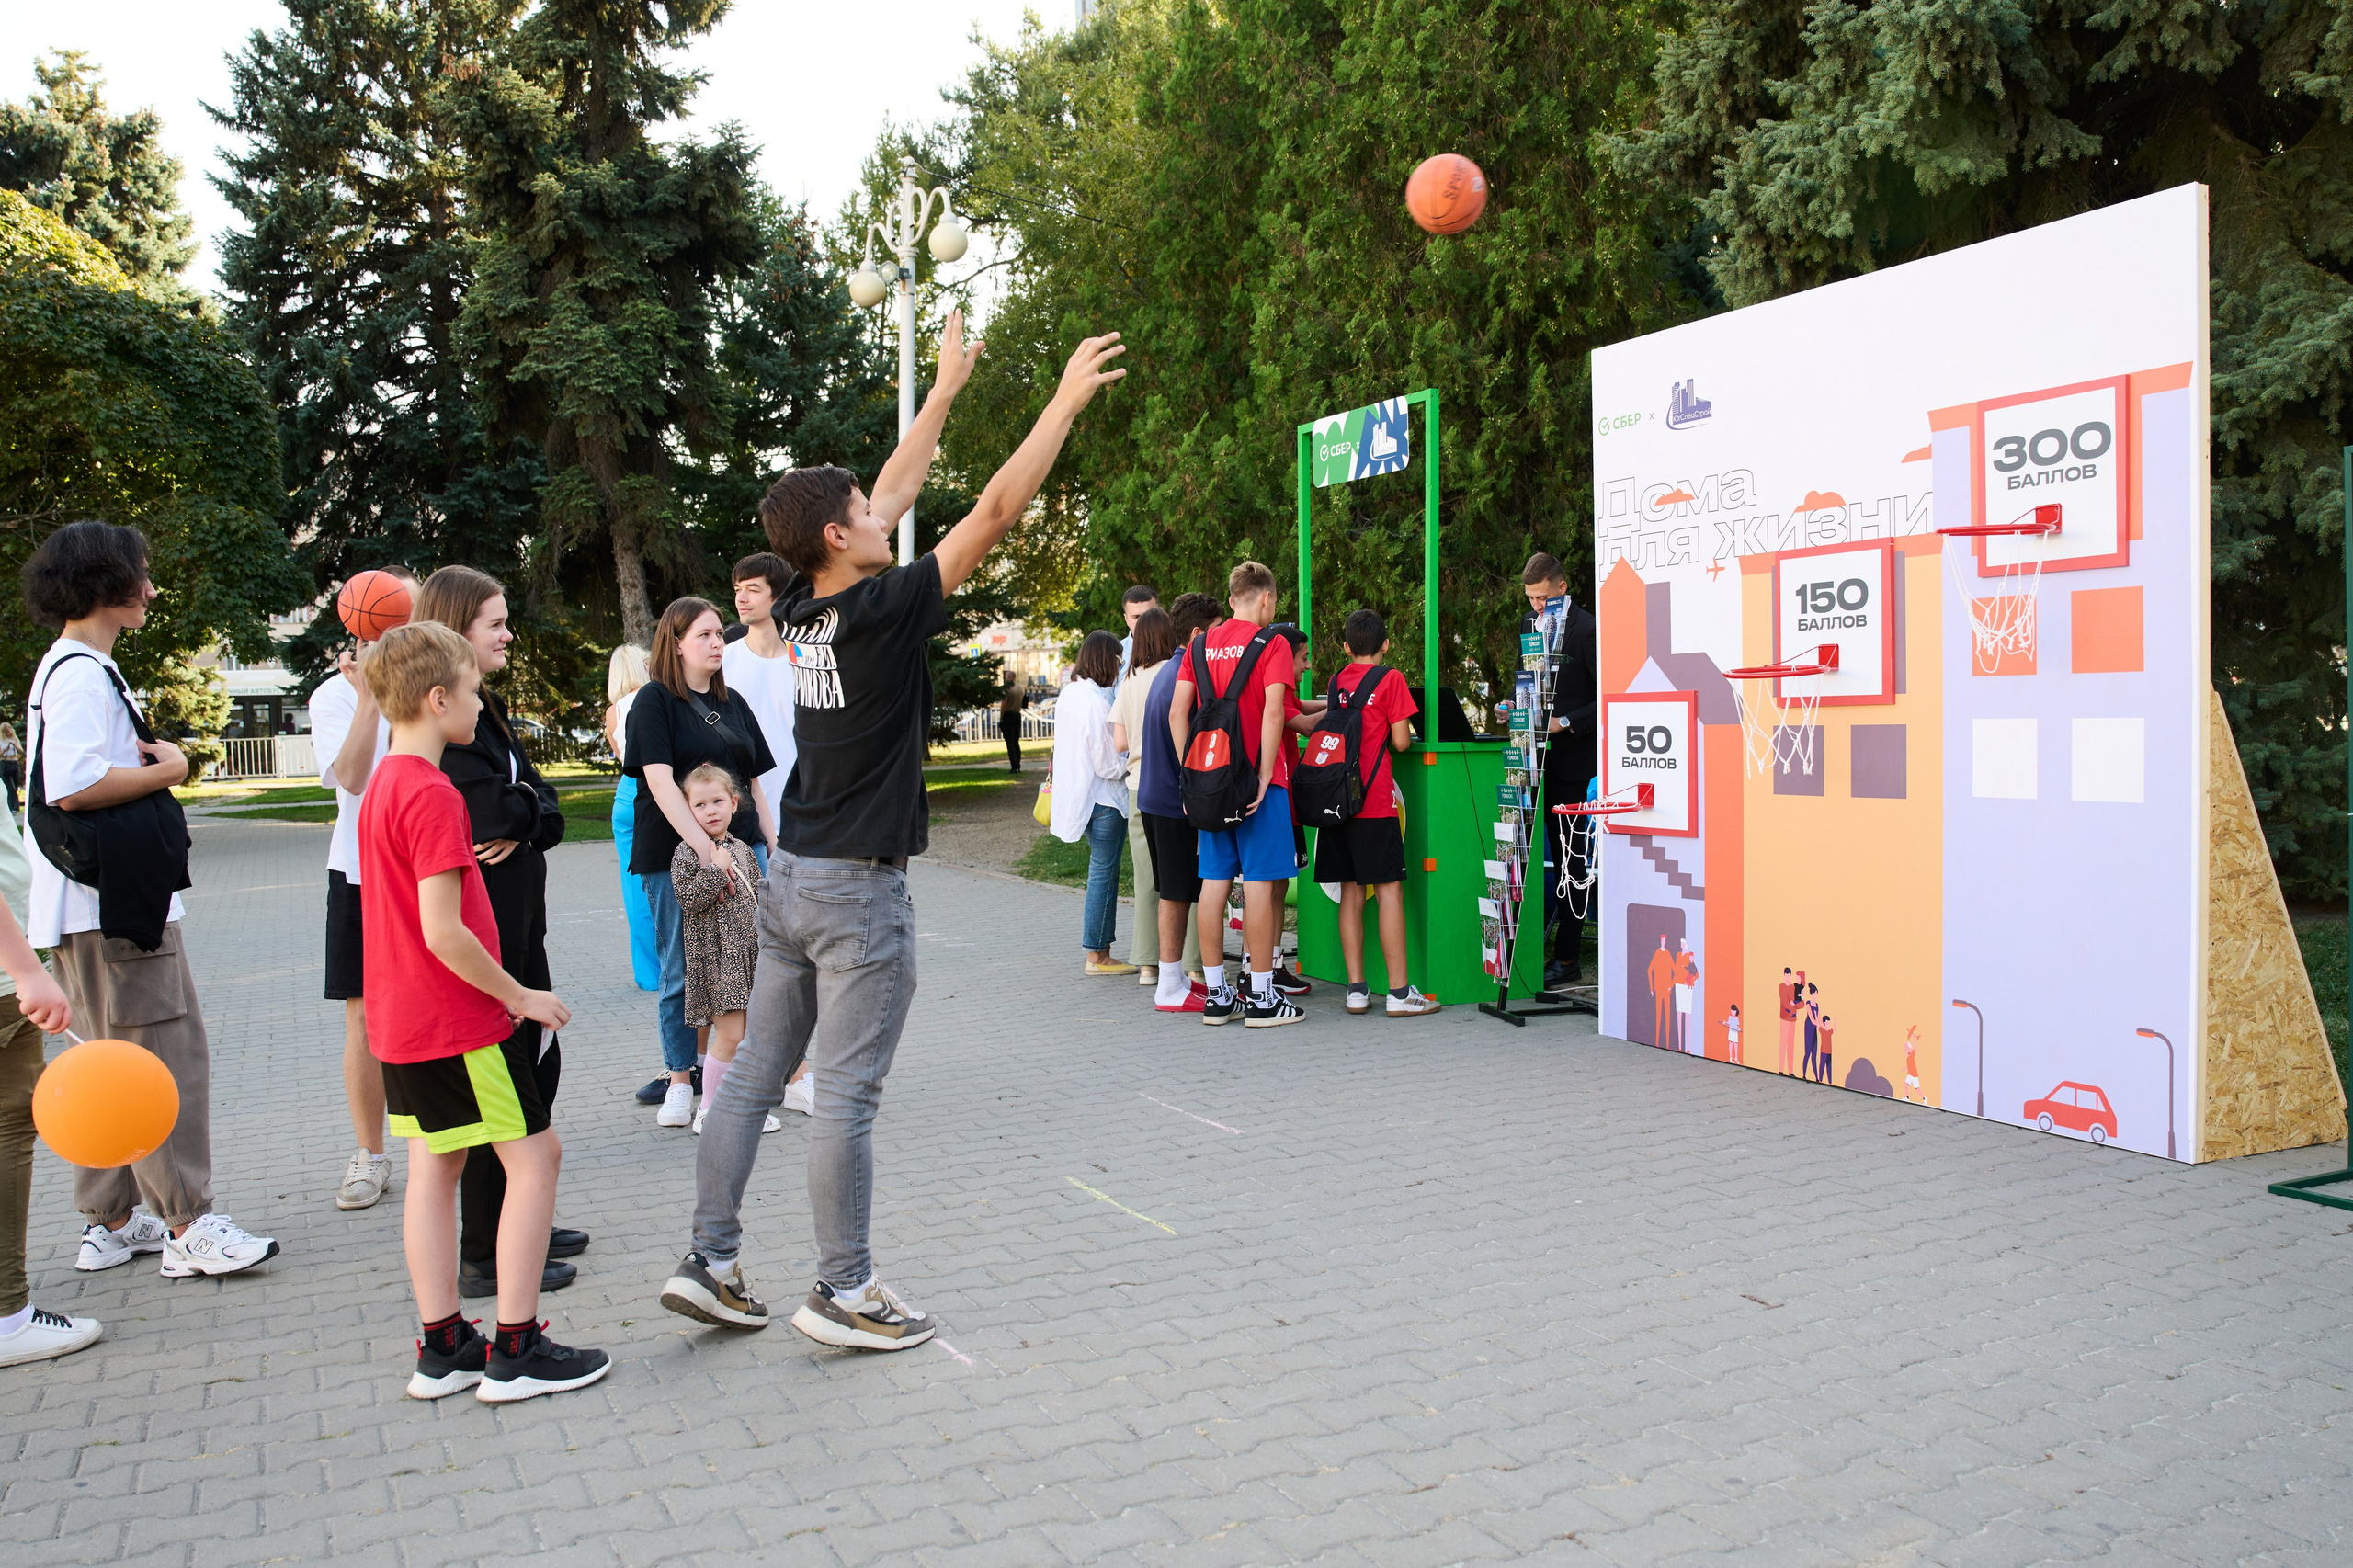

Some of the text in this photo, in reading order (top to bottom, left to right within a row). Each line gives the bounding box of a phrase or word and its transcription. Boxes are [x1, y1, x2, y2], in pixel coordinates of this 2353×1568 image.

[1613, 412, 1642, 430] СБЕР
[1673, 407, 1711, 423] ЮгСпецСтрой
[1330, 441, 1352, 457] СБЕР
[1993, 420, 2112, 473] 300
[2007, 463, 2097, 491] БАЛЛОВ
[1598, 468, 1757, 538] Дома
[1795, 577, 1870, 615] 150
[1797, 614, 1868, 632] БАЛЛОВ
[1209, 733, 1218, 749] 9
[1320, 735, 1340, 751] 99
[1625, 725, 1673, 755] 50
[1621, 756, 1677, 770] БАЛЛОВ
